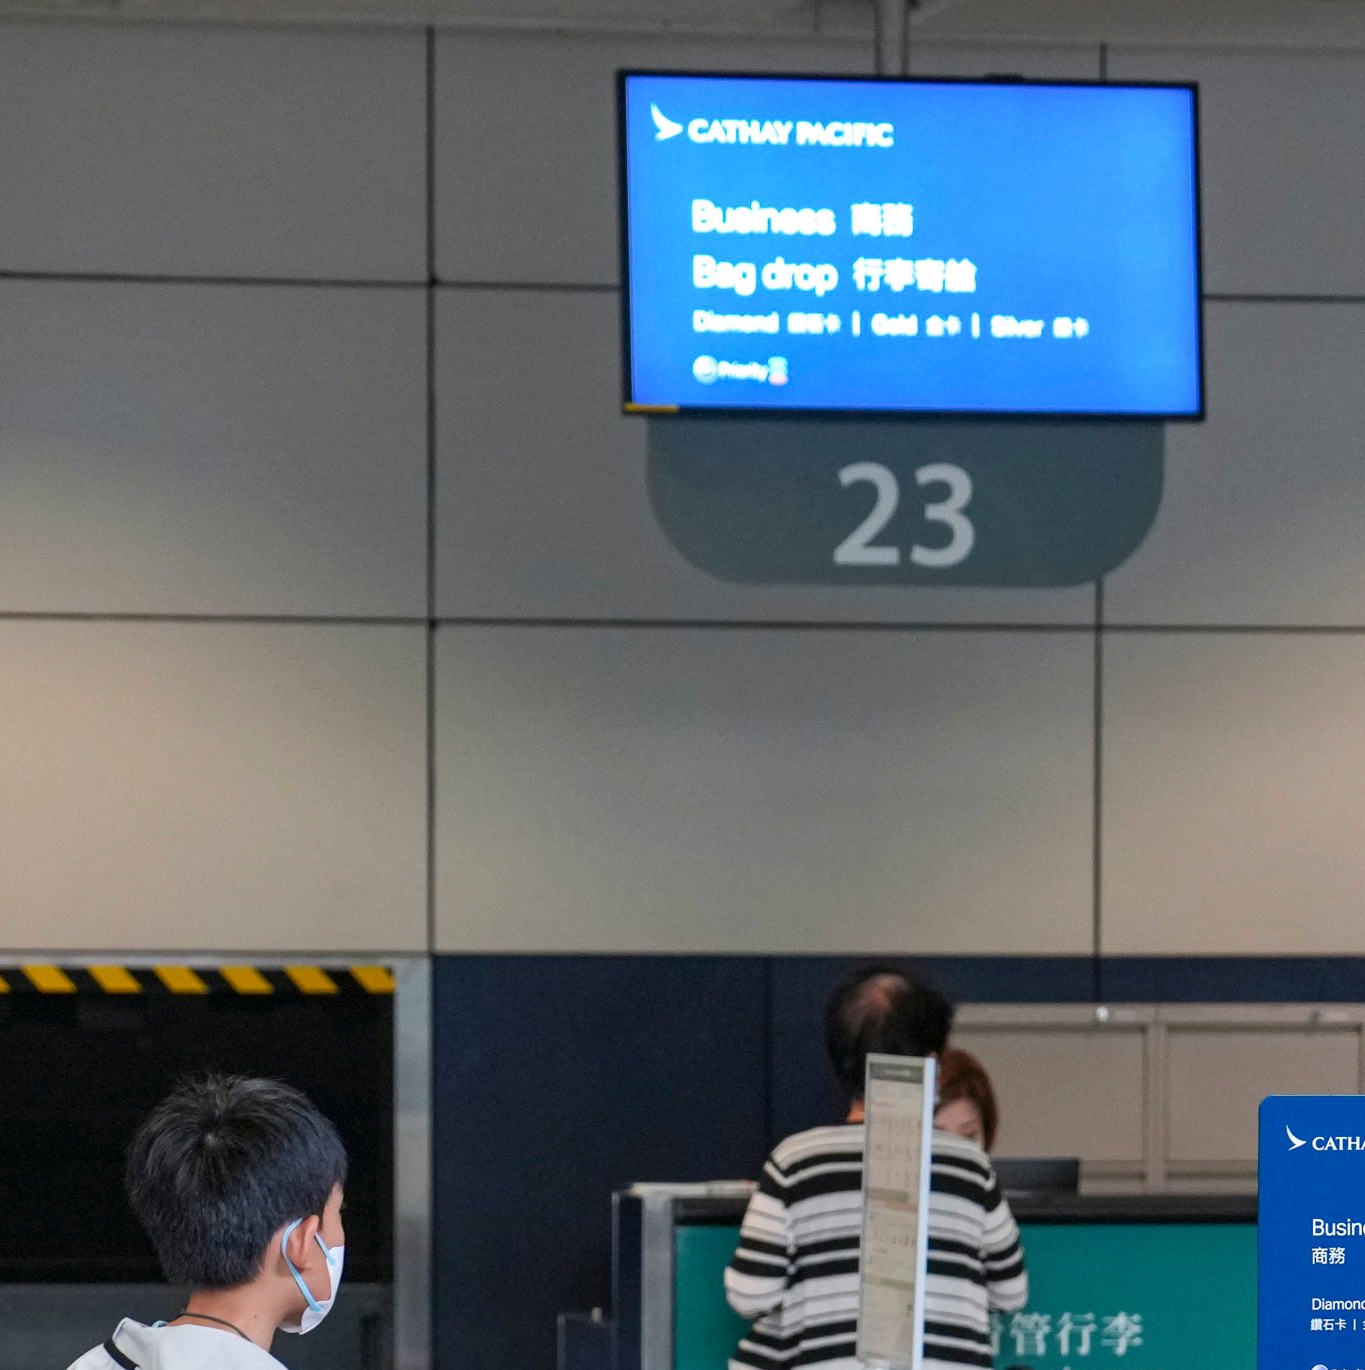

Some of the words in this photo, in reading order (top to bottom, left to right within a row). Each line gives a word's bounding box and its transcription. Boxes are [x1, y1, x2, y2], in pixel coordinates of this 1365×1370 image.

[688, 119, 794, 144] CATHAY
[796, 122, 893, 147] PACIFIC
[692, 199, 836, 235] Business
[693, 255, 756, 296] Bag
[762, 257, 838, 296] drop
[833, 462, 975, 568] 23
[1312, 1247, 1345, 1264] 商務
